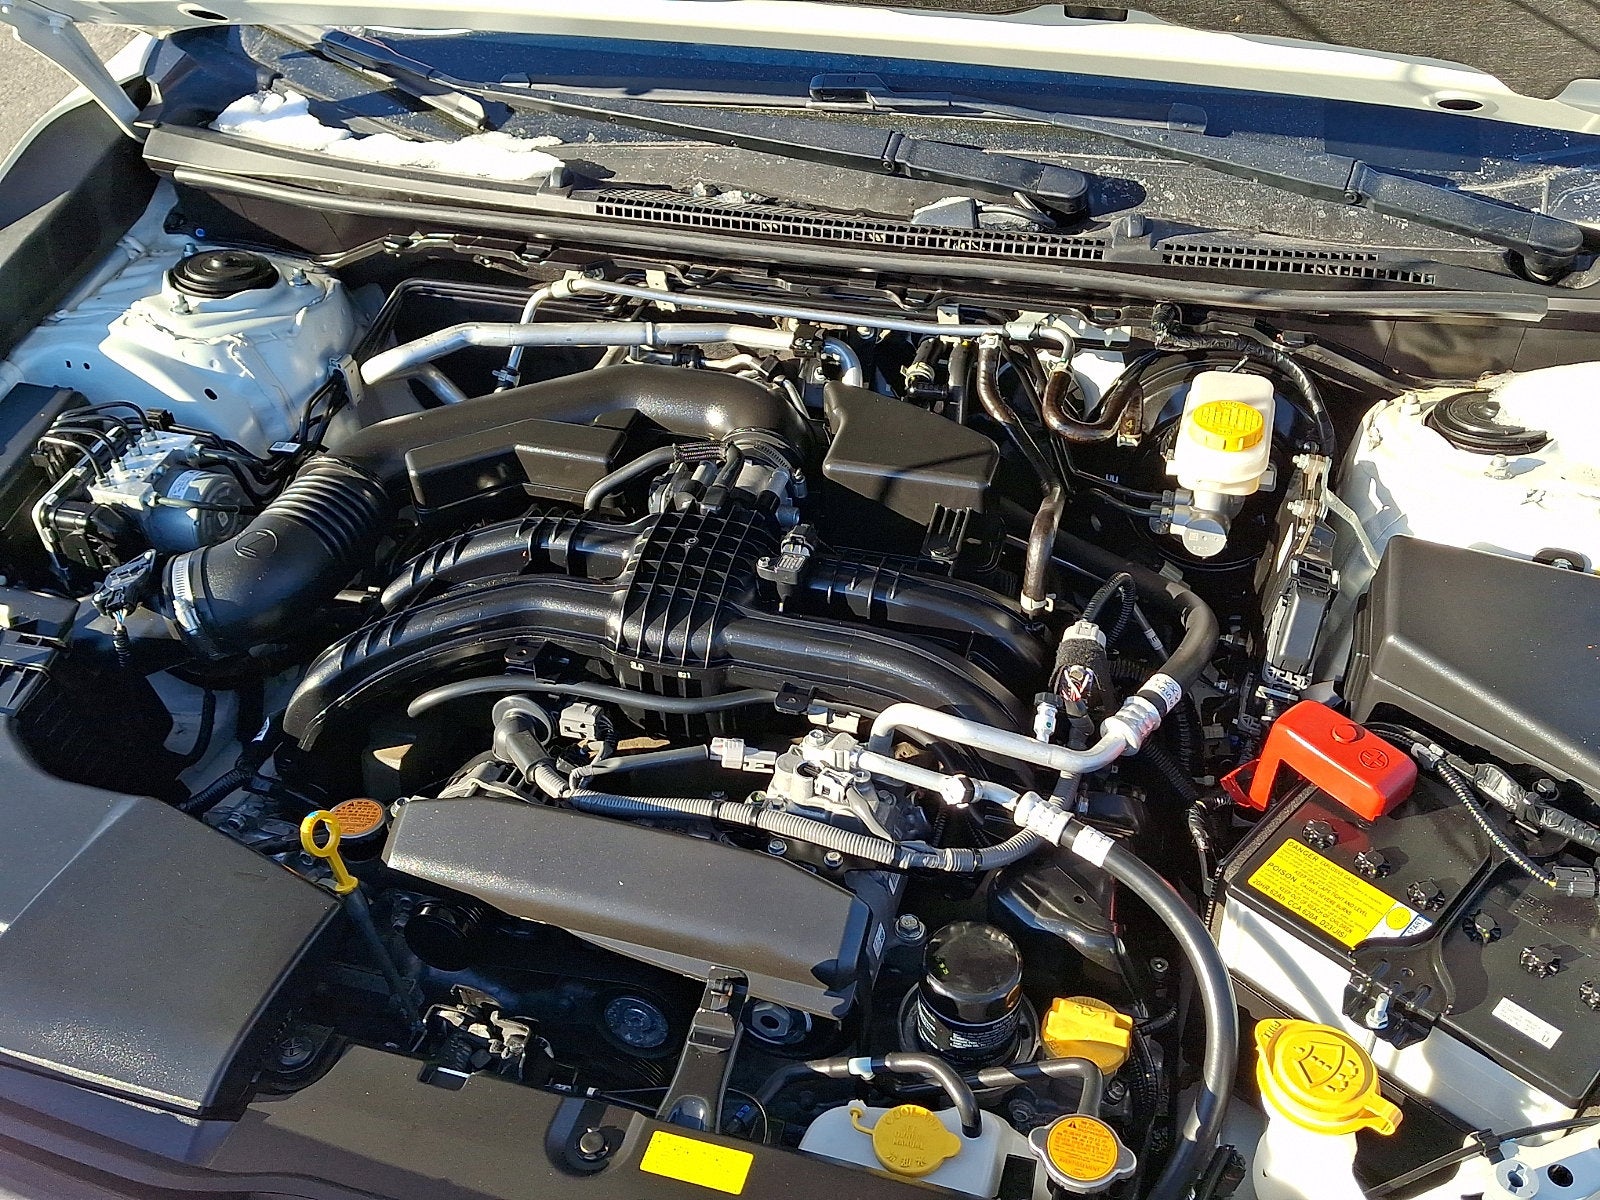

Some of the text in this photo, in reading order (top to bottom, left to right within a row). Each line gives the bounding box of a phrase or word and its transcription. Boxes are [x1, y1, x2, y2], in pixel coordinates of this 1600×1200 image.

[1266, 861, 1297, 882] POISON
[1287, 840, 1319, 862] DANGER
[1252, 878, 1270, 891] 20HR
[1286, 899, 1303, 911] CCA
[1301, 908, 1319, 921] 620A
[1278, 885, 1291, 895] KEEP
[1290, 893, 1301, 901] OUT
[1306, 903, 1323, 915] REACH
[1328, 916, 1353, 933] CHILDREN
[1293, 869, 1307, 879] KEEP
[1306, 877, 1319, 886] VENT
[1343, 899, 1354, 908] AND
[1353, 906, 1369, 917] LEVEL
